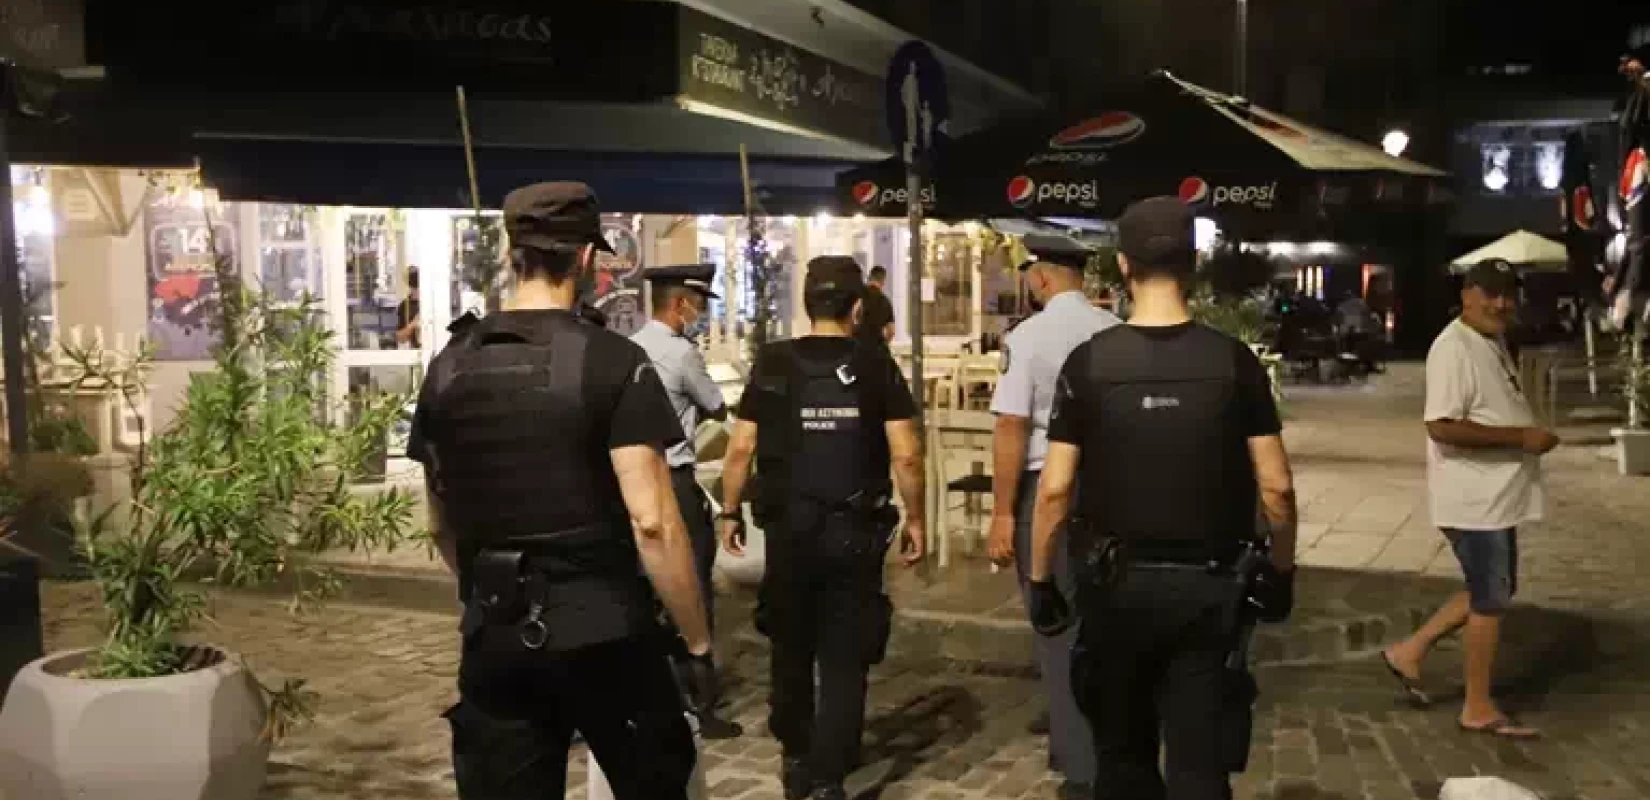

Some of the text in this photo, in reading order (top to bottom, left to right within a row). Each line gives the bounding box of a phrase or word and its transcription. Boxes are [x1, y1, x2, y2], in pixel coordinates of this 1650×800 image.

[880, 183, 936, 206] pesi
[1037, 179, 1098, 204] pepsi
[1213, 180, 1277, 207] pepsi
